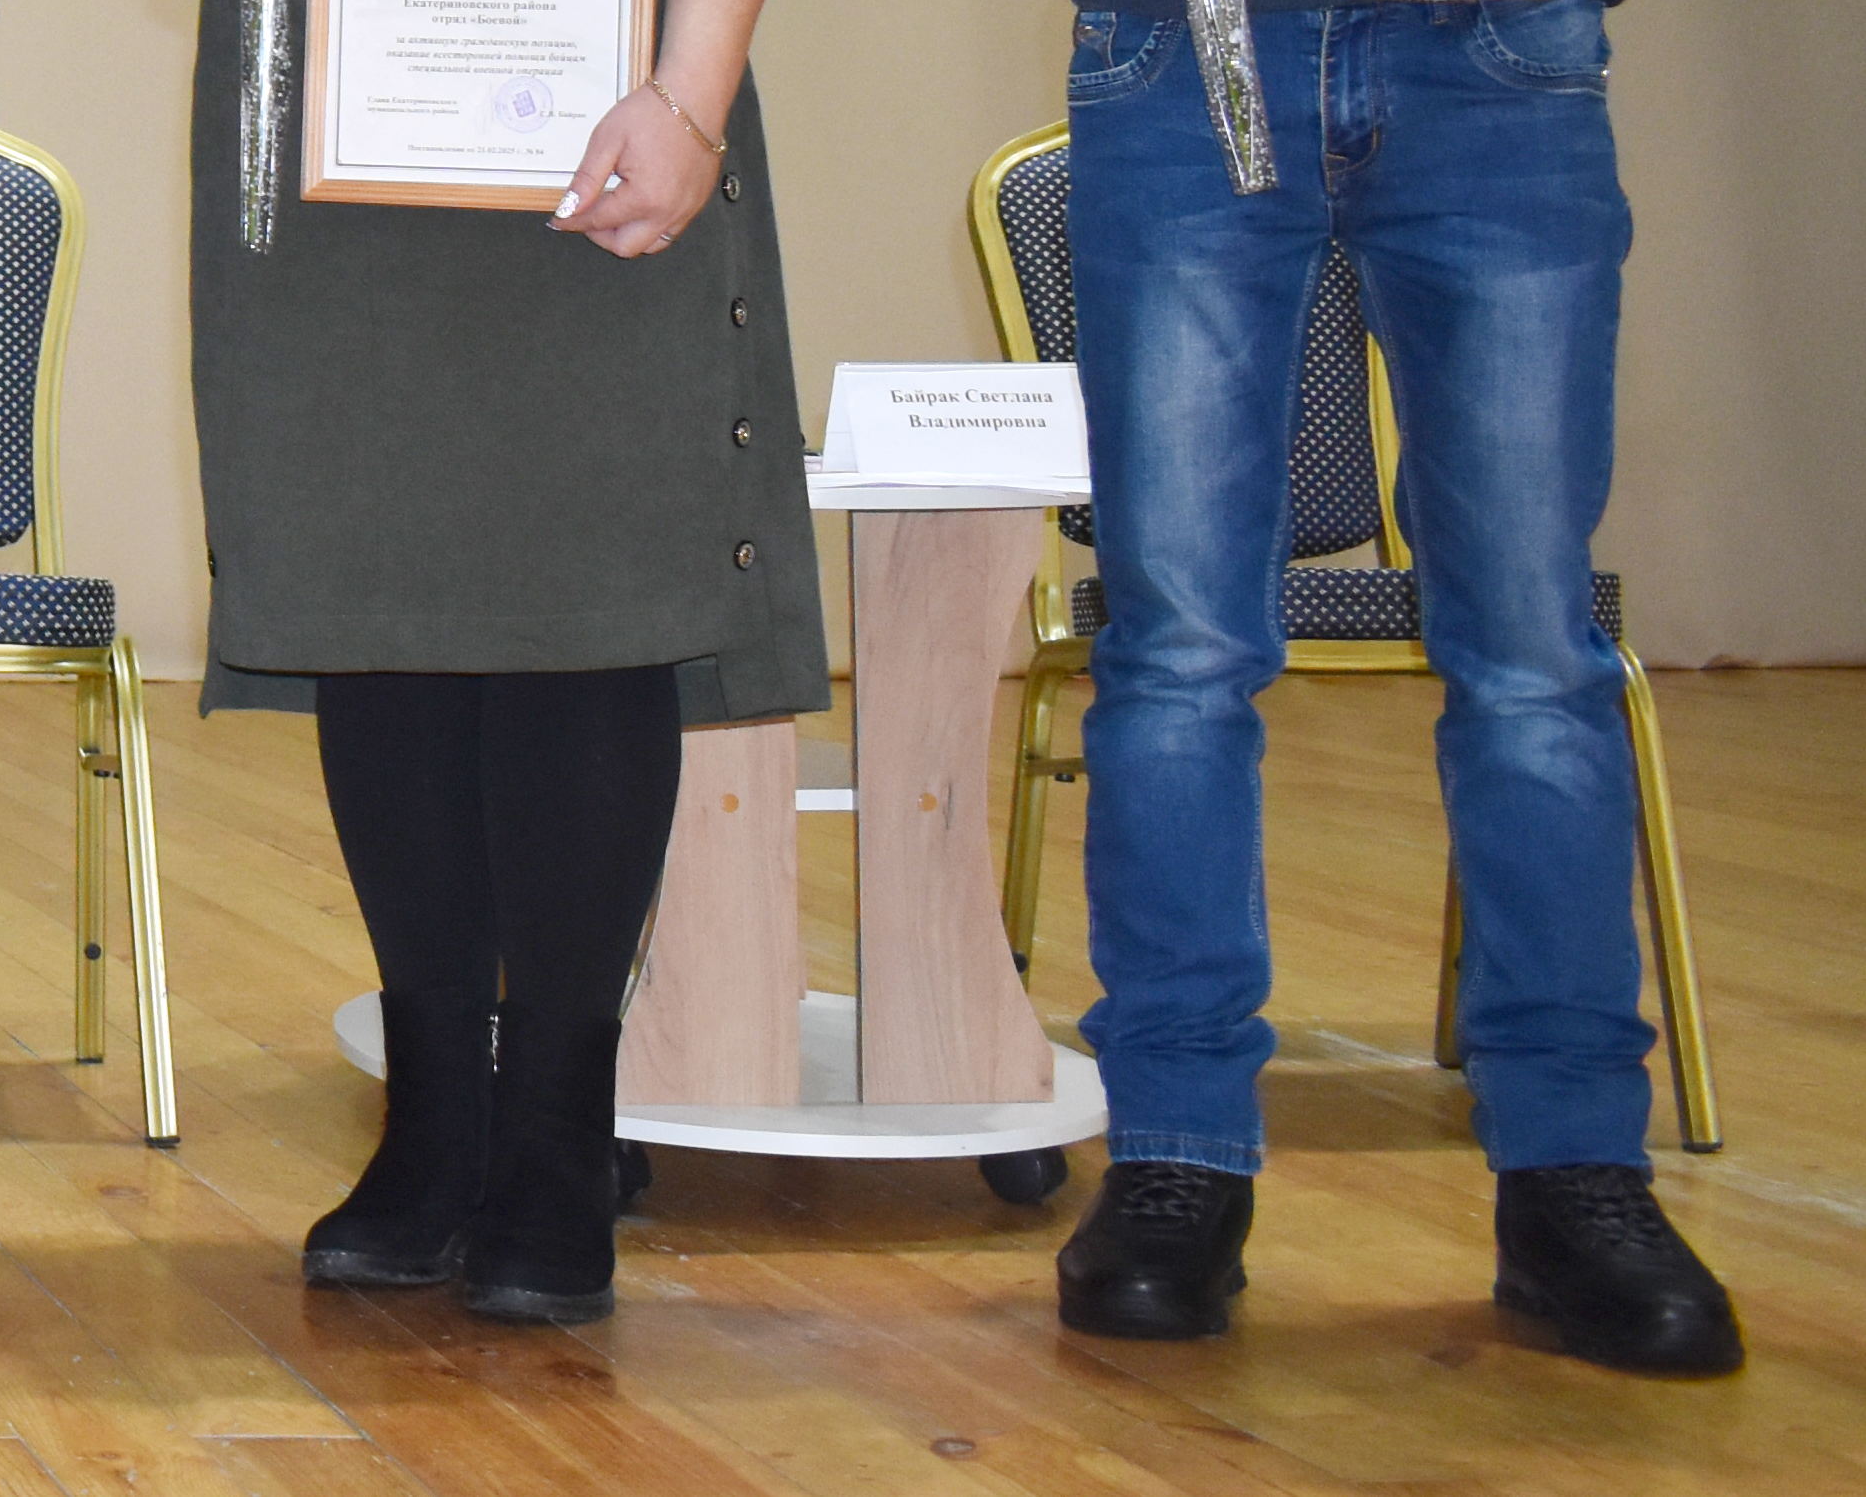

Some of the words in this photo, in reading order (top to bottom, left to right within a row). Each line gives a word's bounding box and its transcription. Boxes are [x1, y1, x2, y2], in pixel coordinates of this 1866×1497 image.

[513, 0, 558, 12] района
[890, 389, 959, 407] Байрак
[965, 388, 1054, 404] Светлана
[908, 414, 1047, 432] Владимировна
